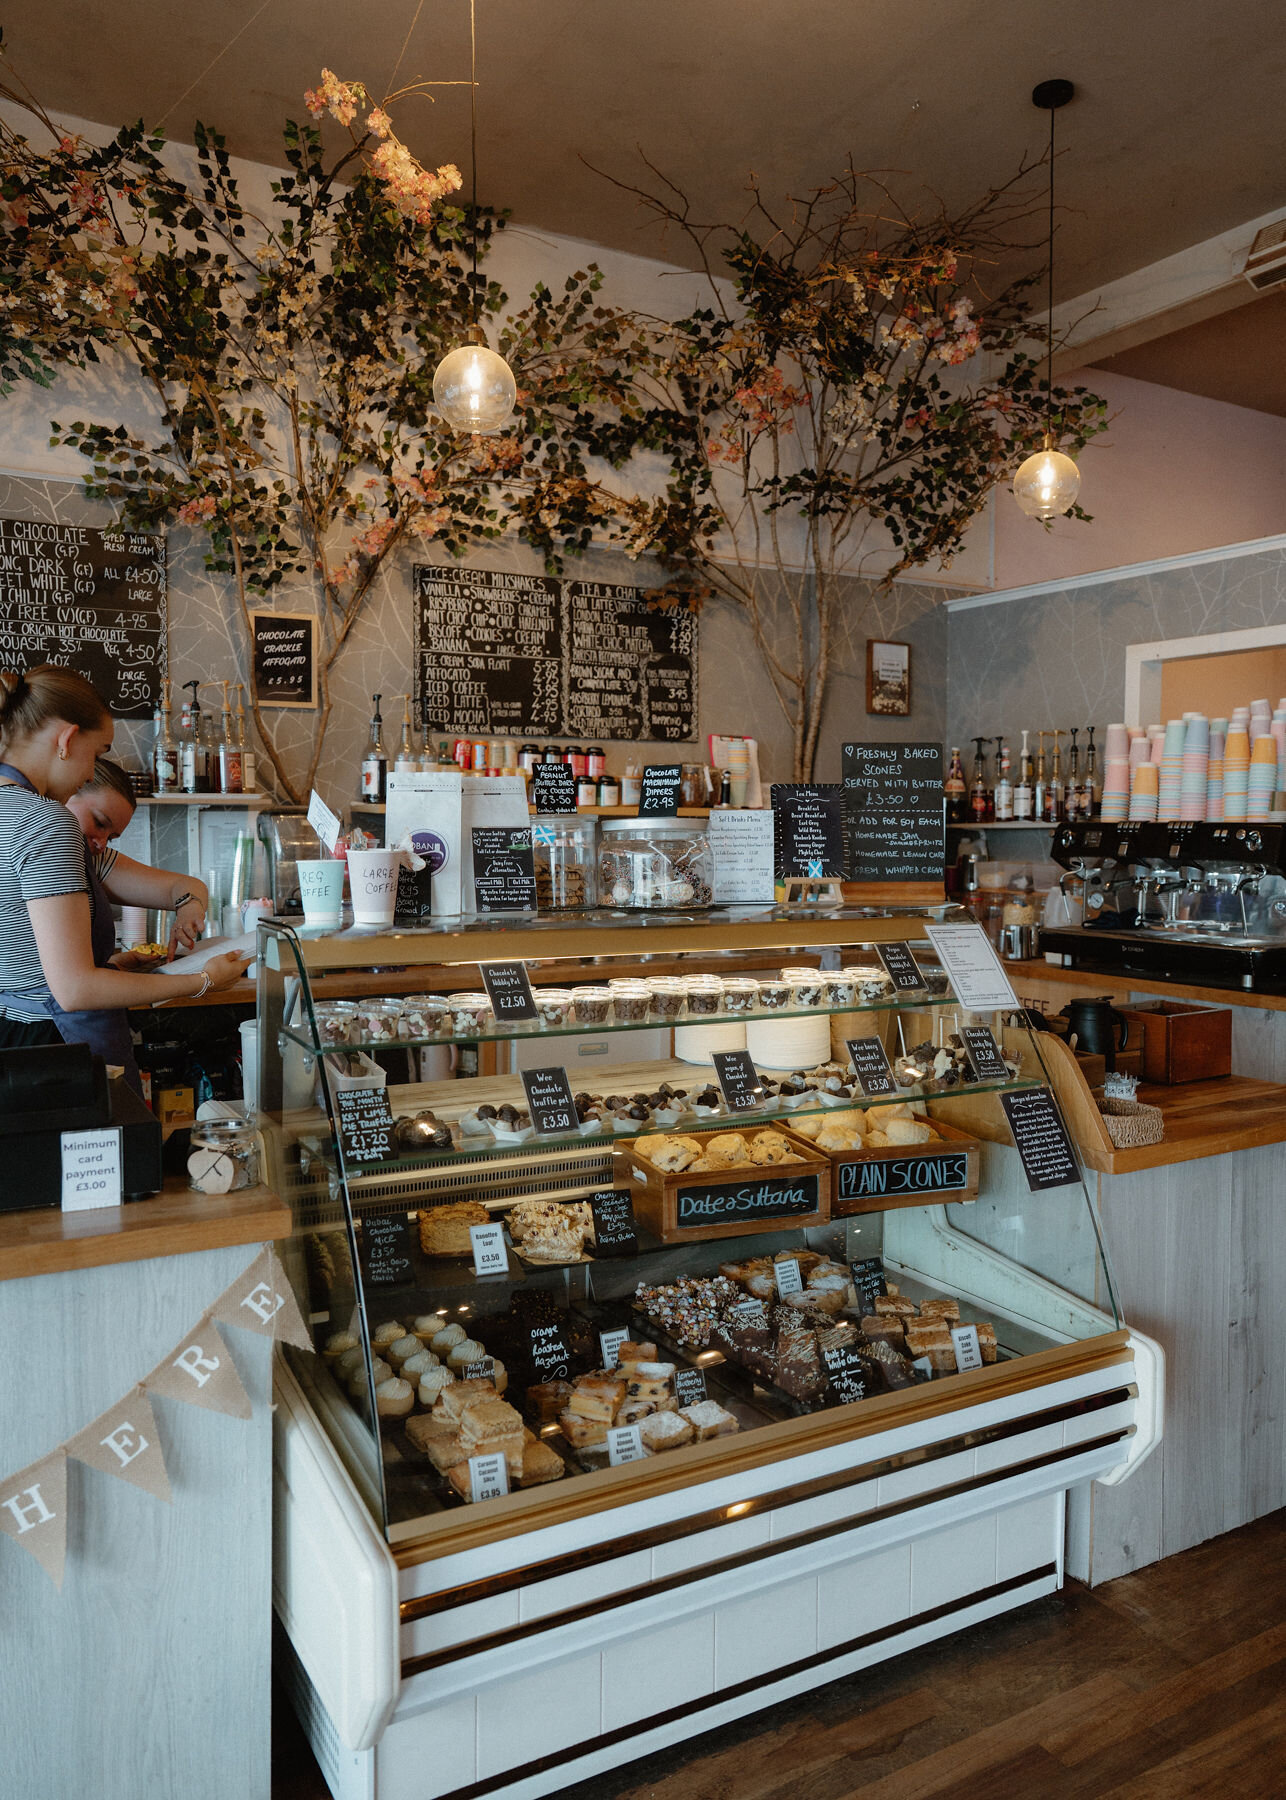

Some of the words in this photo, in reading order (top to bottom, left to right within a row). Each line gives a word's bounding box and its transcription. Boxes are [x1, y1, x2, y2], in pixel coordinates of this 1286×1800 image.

[14, 522, 88, 543] CHOCOLATE
[129, 535, 147, 544] WITH
[11, 540, 45, 557] MILK
[104, 542, 124, 552] FRESH
[129, 545, 154, 555] CREAM
[29, 558, 65, 575] DARK
[104, 568, 120, 580] ALL
[30, 574, 69, 592] WHITE
[491, 573, 546, 592] MILKSHAKES
[8, 588, 46, 605] CHILLI
[129, 589, 153, 601] LARGE
[422, 582, 460, 597] VANILLA
[529, 592, 555, 607] CREAM
[578, 582, 600, 597] TEA
[605, 586, 612, 597] &
[616, 586, 636, 600] CHAI
[429, 596, 472, 612] RASPBERRY
[485, 601, 514, 615] SALTED
[518, 603, 552, 618] CARAMEL
[19, 606, 49, 621] FREE
[573, 609, 600, 622] LONDON
[603, 612, 618, 624] FOG
[424, 609, 445, 623] MINT
[447, 611, 469, 625] CHOC
[471, 613, 488, 627] CHIP
[496, 614, 515, 629] CHOC
[519, 616, 555, 631] HAZELNUT
[22, 623, 55, 637] ORIGIN
[59, 625, 76, 638] HOT
[80, 627, 126, 641] CHOCOLATE
[257, 630, 306, 640] CHOCOLATE
[428, 623, 461, 638] BISCOFF
[471, 627, 503, 641] COOKIES
[515, 630, 545, 645] CREAM
[430, 638, 470, 652] BANANA
[573, 633, 600, 648] WHITE
[603, 637, 623, 650] CHOC
[59, 640, 82, 652] 35%
[104, 643, 119, 657] REG
[264, 643, 303, 653] CRACKLE
[46, 653, 69, 667] 40%
[263, 656, 306, 667] AFFOGATO
[468, 656, 485, 669] SODA
[488, 659, 511, 671] FLOAT
[118, 671, 147, 681] LARGE
[426, 667, 470, 680] AFFOGATO
[426, 680, 449, 694] ICED
[452, 682, 488, 695] COFFEE
[427, 694, 449, 707] ICED
[454, 695, 483, 708] LATTE
[427, 708, 450, 723] ICED
[454, 710, 485, 724] MOCHA
[445, 724, 466, 734] PLEASE
[525, 726, 549, 736] OPTIONS
[857, 748, 896, 761] FRESHLY
[904, 748, 938, 759] BAKED
[863, 764, 902, 775] SCONES
[844, 778, 879, 787] SERVED
[885, 780, 908, 788] WITH
[912, 779, 943, 788] BUTTER
[860, 816, 877, 824] ADD
[883, 817, 898, 825] FOR
[919, 818, 940, 826] EACH
[900, 832, 920, 840] JAM
[363, 868, 394, 879] LARGE
[886, 866, 919, 874] WHIPPED
[302, 870, 323, 884] REG
[489, 968, 516, 976] Chocolate
[899, 976, 918, 985] £2.50
[500, 996, 525, 1008] £2.50
[966, 1029, 989, 1037] Chocolate
[851, 1043, 863, 1051] Wee
[864, 1043, 878, 1051] boozy
[970, 1040, 985, 1049] Lucky
[855, 1052, 880, 1061] Chocolate
[976, 1050, 995, 1060] £3.50
[858, 1063, 877, 1071] truffle
[878, 1062, 886, 1071] pot
[536, 1073, 552, 1082] Wee
[726, 1072, 747, 1080] Chocolate
[531, 1084, 562, 1095] Chocolate
[868, 1079, 889, 1091] £3.50
[338, 1089, 374, 1099] CHOCOLATE
[358, 1096, 383, 1104] MONTH
[533, 1096, 557, 1107] truffle
[558, 1094, 569, 1106] pot
[736, 1095, 756, 1107] £3.50
[341, 1112, 359, 1122] KEY
[364, 1108, 386, 1118] LIME
[543, 1113, 569, 1129] £3.50
[342, 1122, 357, 1132] PIE
[358, 1116, 393, 1128] TRUFFLE
[64, 1140, 116, 1151] Minimum
[78, 1154, 102, 1163] card
[66, 1167, 116, 1180] payment
[841, 1163, 886, 1195] PLAIN
[890, 1160, 966, 1189] SCONES
[76, 1181, 106, 1191] £3.00
[680, 1196, 723, 1216] Date
[736, 1186, 808, 1211] Sultana
[366, 1215, 392, 1226] Dubai
[370, 1224, 404, 1236] Chocolate
[482, 1253, 499, 1262] £3.50
[531, 1325, 559, 1338] Orange
[532, 1341, 564, 1356] Roasted
[535, 1350, 569, 1369] Hazelnut
[478, 1460, 498, 1468] Caramel
[481, 1488, 500, 1499] £3.95
